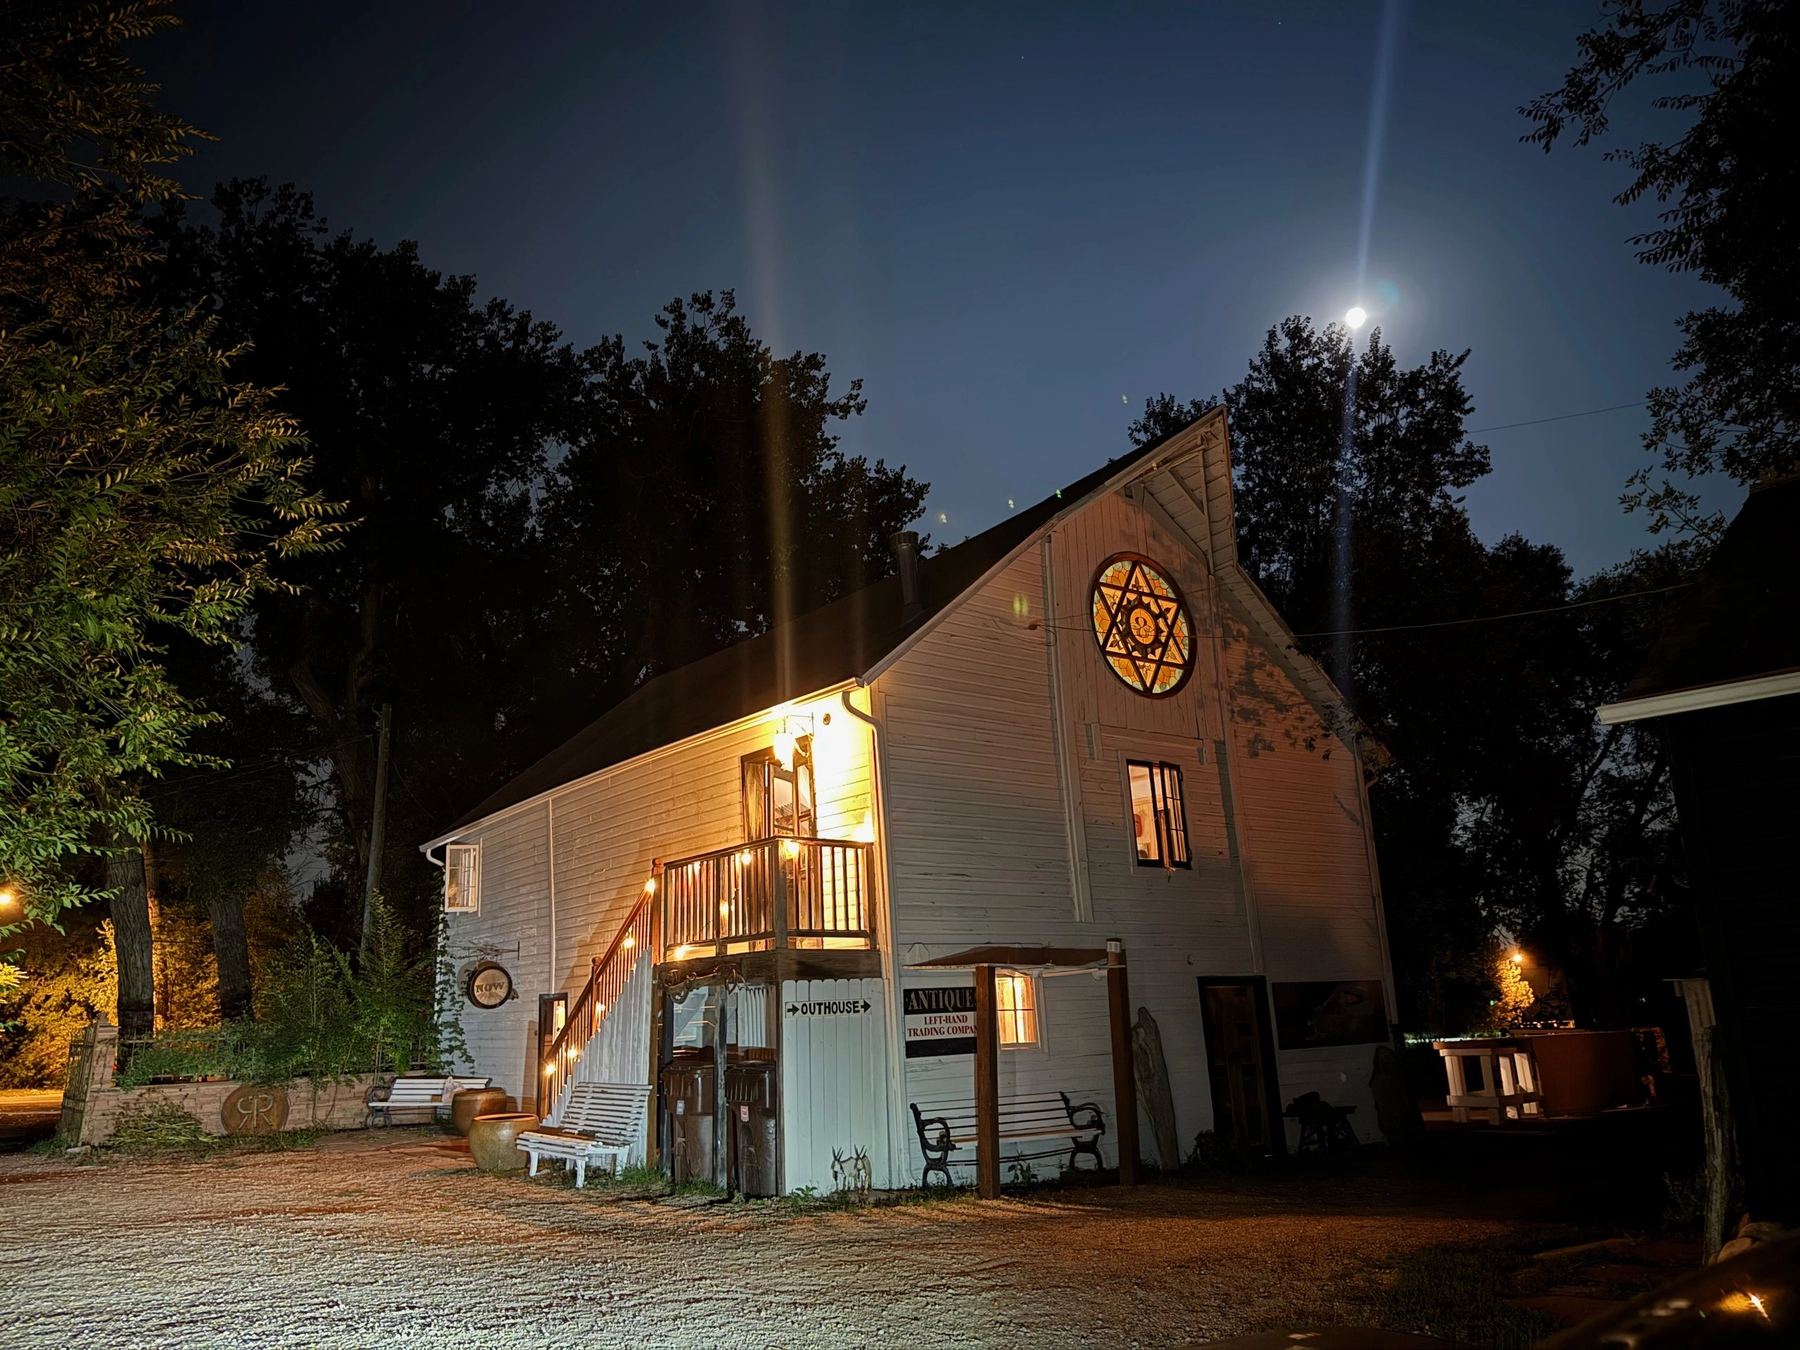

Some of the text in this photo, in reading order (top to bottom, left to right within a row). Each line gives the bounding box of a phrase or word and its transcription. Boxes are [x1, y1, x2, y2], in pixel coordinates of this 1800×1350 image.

[475, 981, 505, 993] NOW
[908, 988, 976, 1011] ANTIQUE
[801, 1000, 860, 1015] OUTHOUSE
[924, 1014, 968, 1025] LEFT-HAND
[907, 1026, 945, 1037] TRADING
